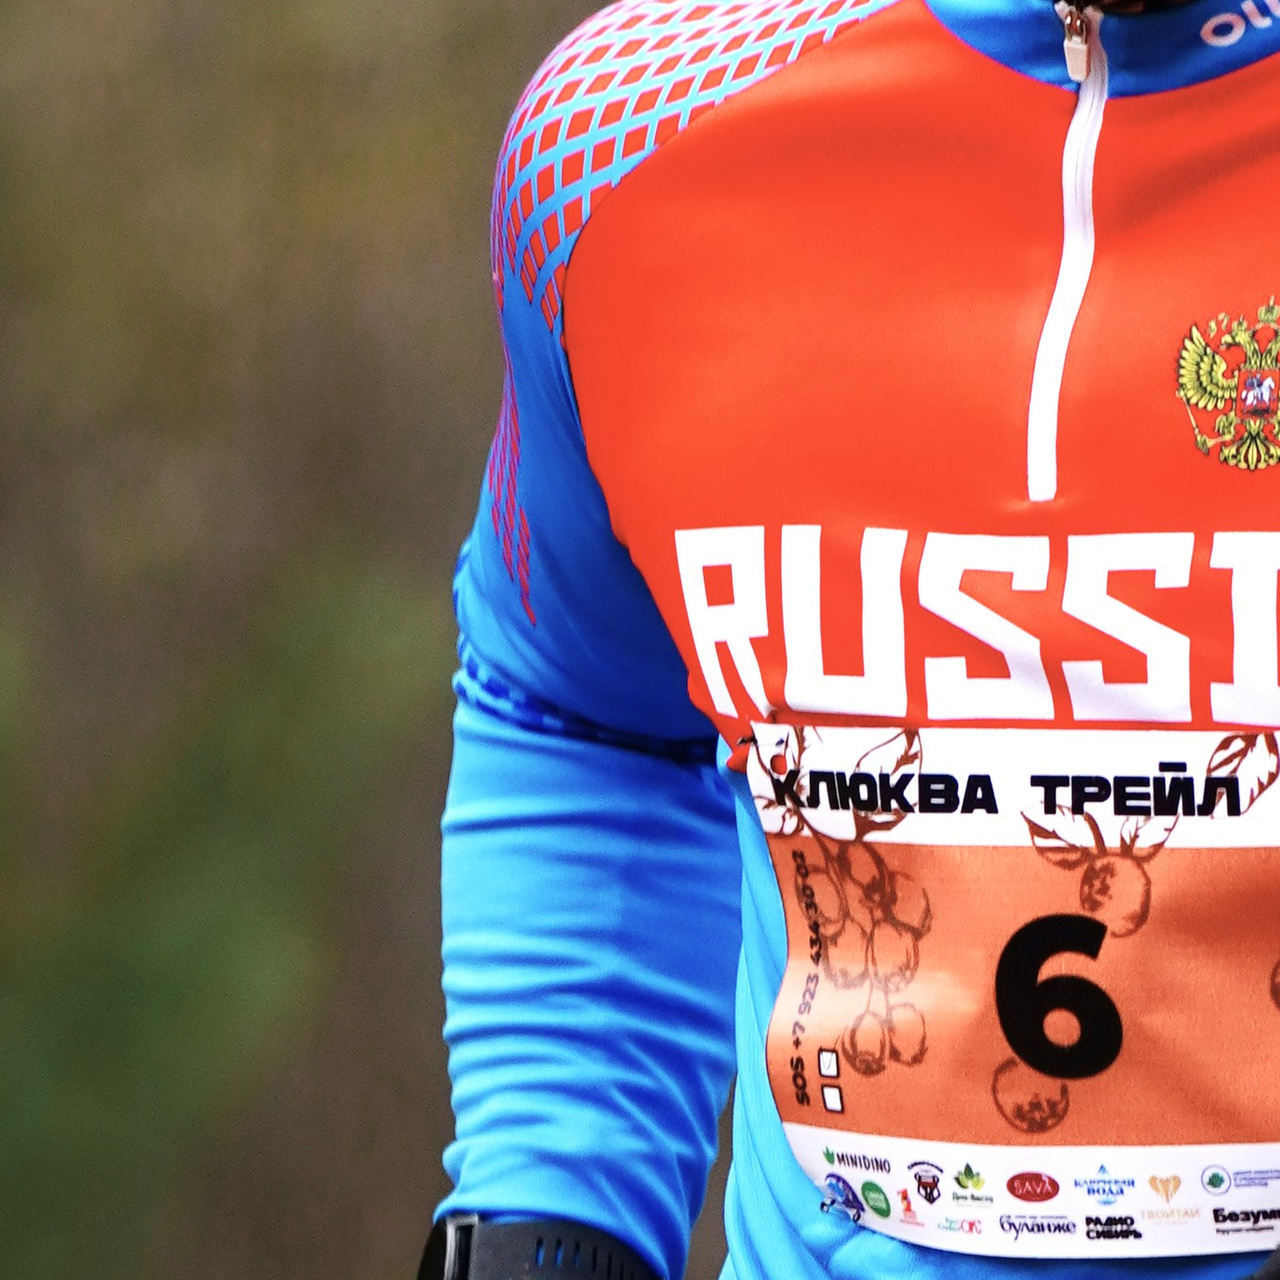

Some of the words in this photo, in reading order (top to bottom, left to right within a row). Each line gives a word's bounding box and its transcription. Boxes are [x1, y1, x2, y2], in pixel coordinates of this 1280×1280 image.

[769, 770, 999, 814] КЛЮКВА
[1030, 761, 1241, 817] ТРЕЙЛ
[798, 972, 819, 1015] 923
[995, 913, 1123, 1080] 6
[792, 1021, 806, 1050] +7
[790, 1056, 811, 1106] SOS
[836, 1152, 891, 1174] MINIDINO
[1013, 1178, 1053, 1195] SAVA
[999, 1214, 1077, 1242] буланже
[1085, 1215, 1135, 1227] РАДИО
[1085, 1229, 1143, 1240] СИБИРЬ
